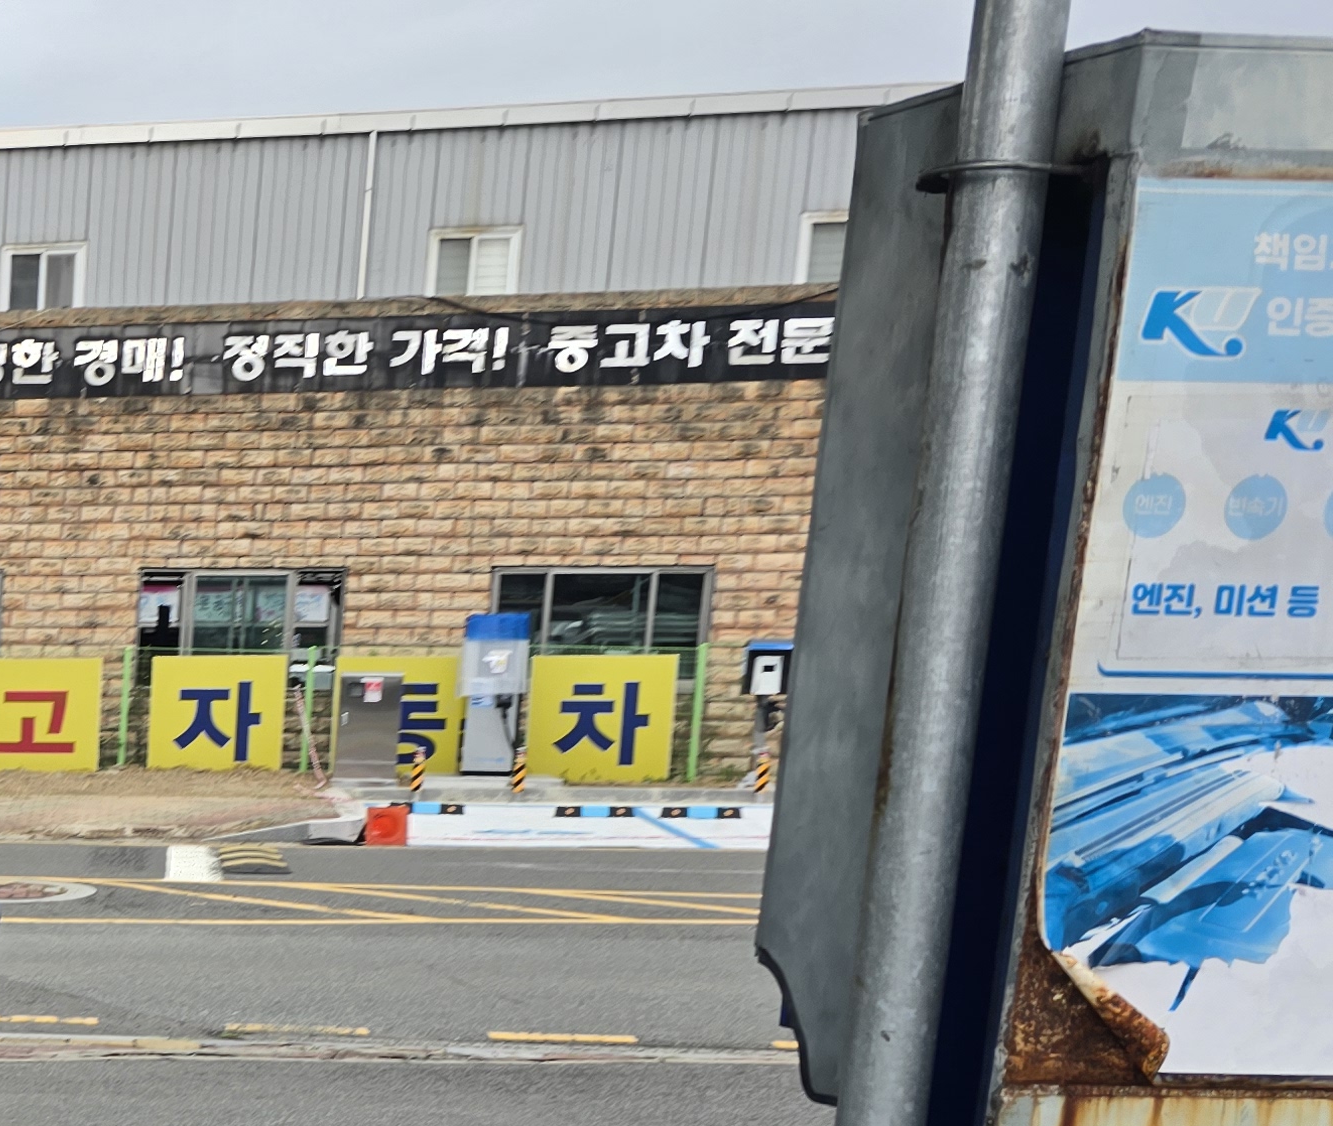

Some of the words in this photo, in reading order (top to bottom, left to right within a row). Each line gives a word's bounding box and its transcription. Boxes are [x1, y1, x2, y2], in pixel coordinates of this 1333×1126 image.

[1253, 232, 1333, 272] 책임
[73, 336, 185, 387] 경매!
[223, 329, 374, 382] 정직한
[388, 325, 511, 376] 가격!
[547, 318, 711, 374] 중고차
[1130, 582, 1202, 619] 엔진,
[1214, 583, 1279, 617] 미션
[1287, 585, 1320, 618] 등
